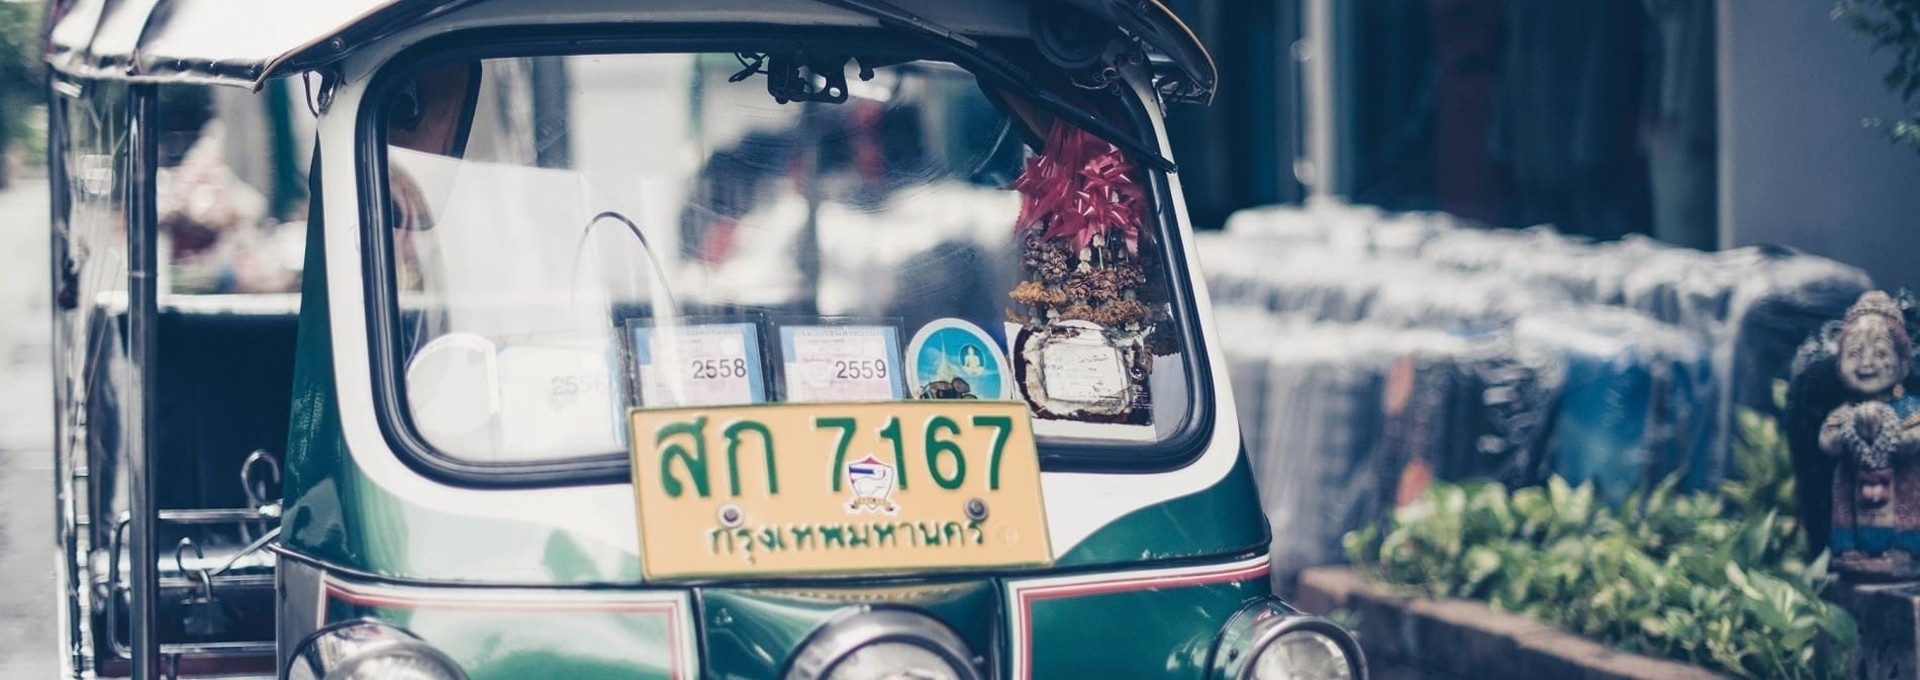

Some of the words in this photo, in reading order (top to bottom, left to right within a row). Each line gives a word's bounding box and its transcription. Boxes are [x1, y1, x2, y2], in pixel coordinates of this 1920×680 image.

[692, 358, 747, 380] 2558
[835, 358, 887, 380] 2559
[656, 415, 779, 498] สก
[815, 415, 1013, 491] 7167
[709, 519, 985, 565] กรุงเทพมหานคร
